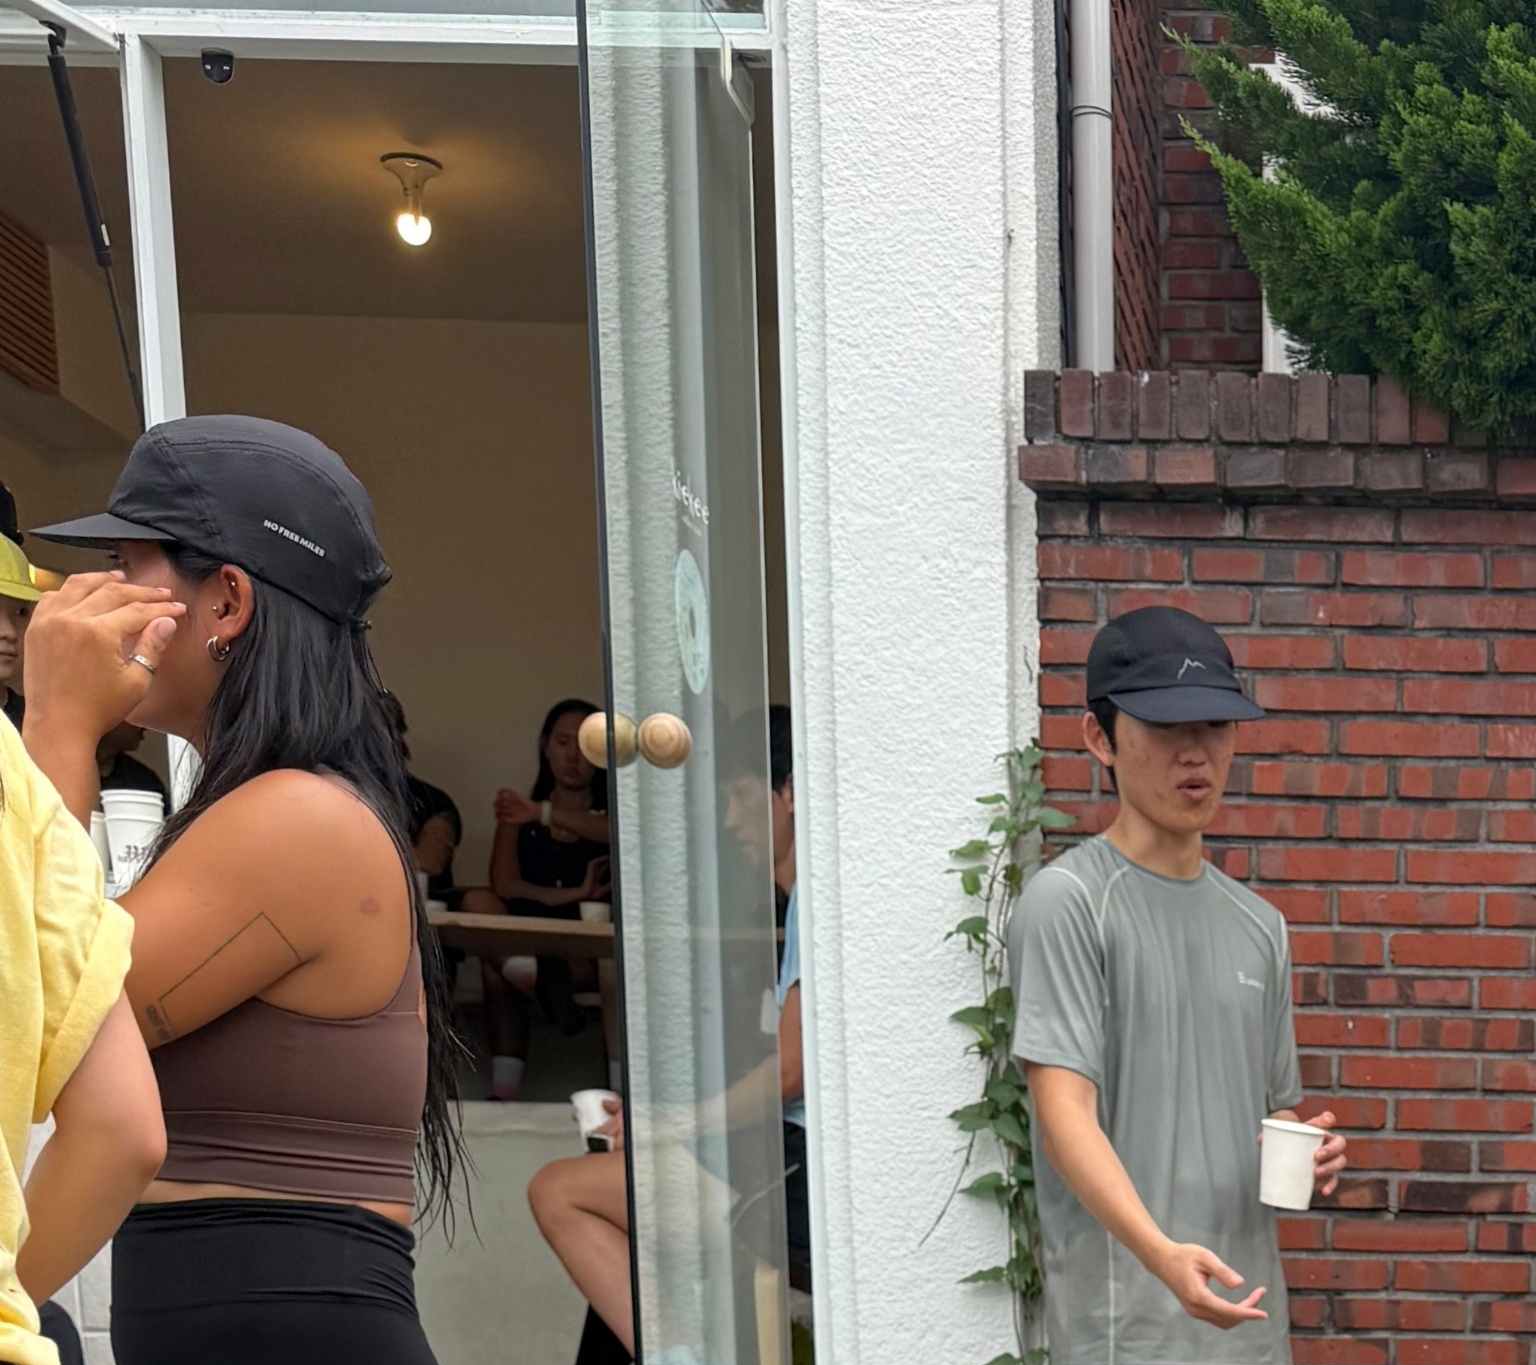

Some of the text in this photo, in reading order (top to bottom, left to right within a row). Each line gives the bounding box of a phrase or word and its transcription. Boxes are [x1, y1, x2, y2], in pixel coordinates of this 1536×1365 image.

[263, 519, 325, 557] NO FREE MILES
